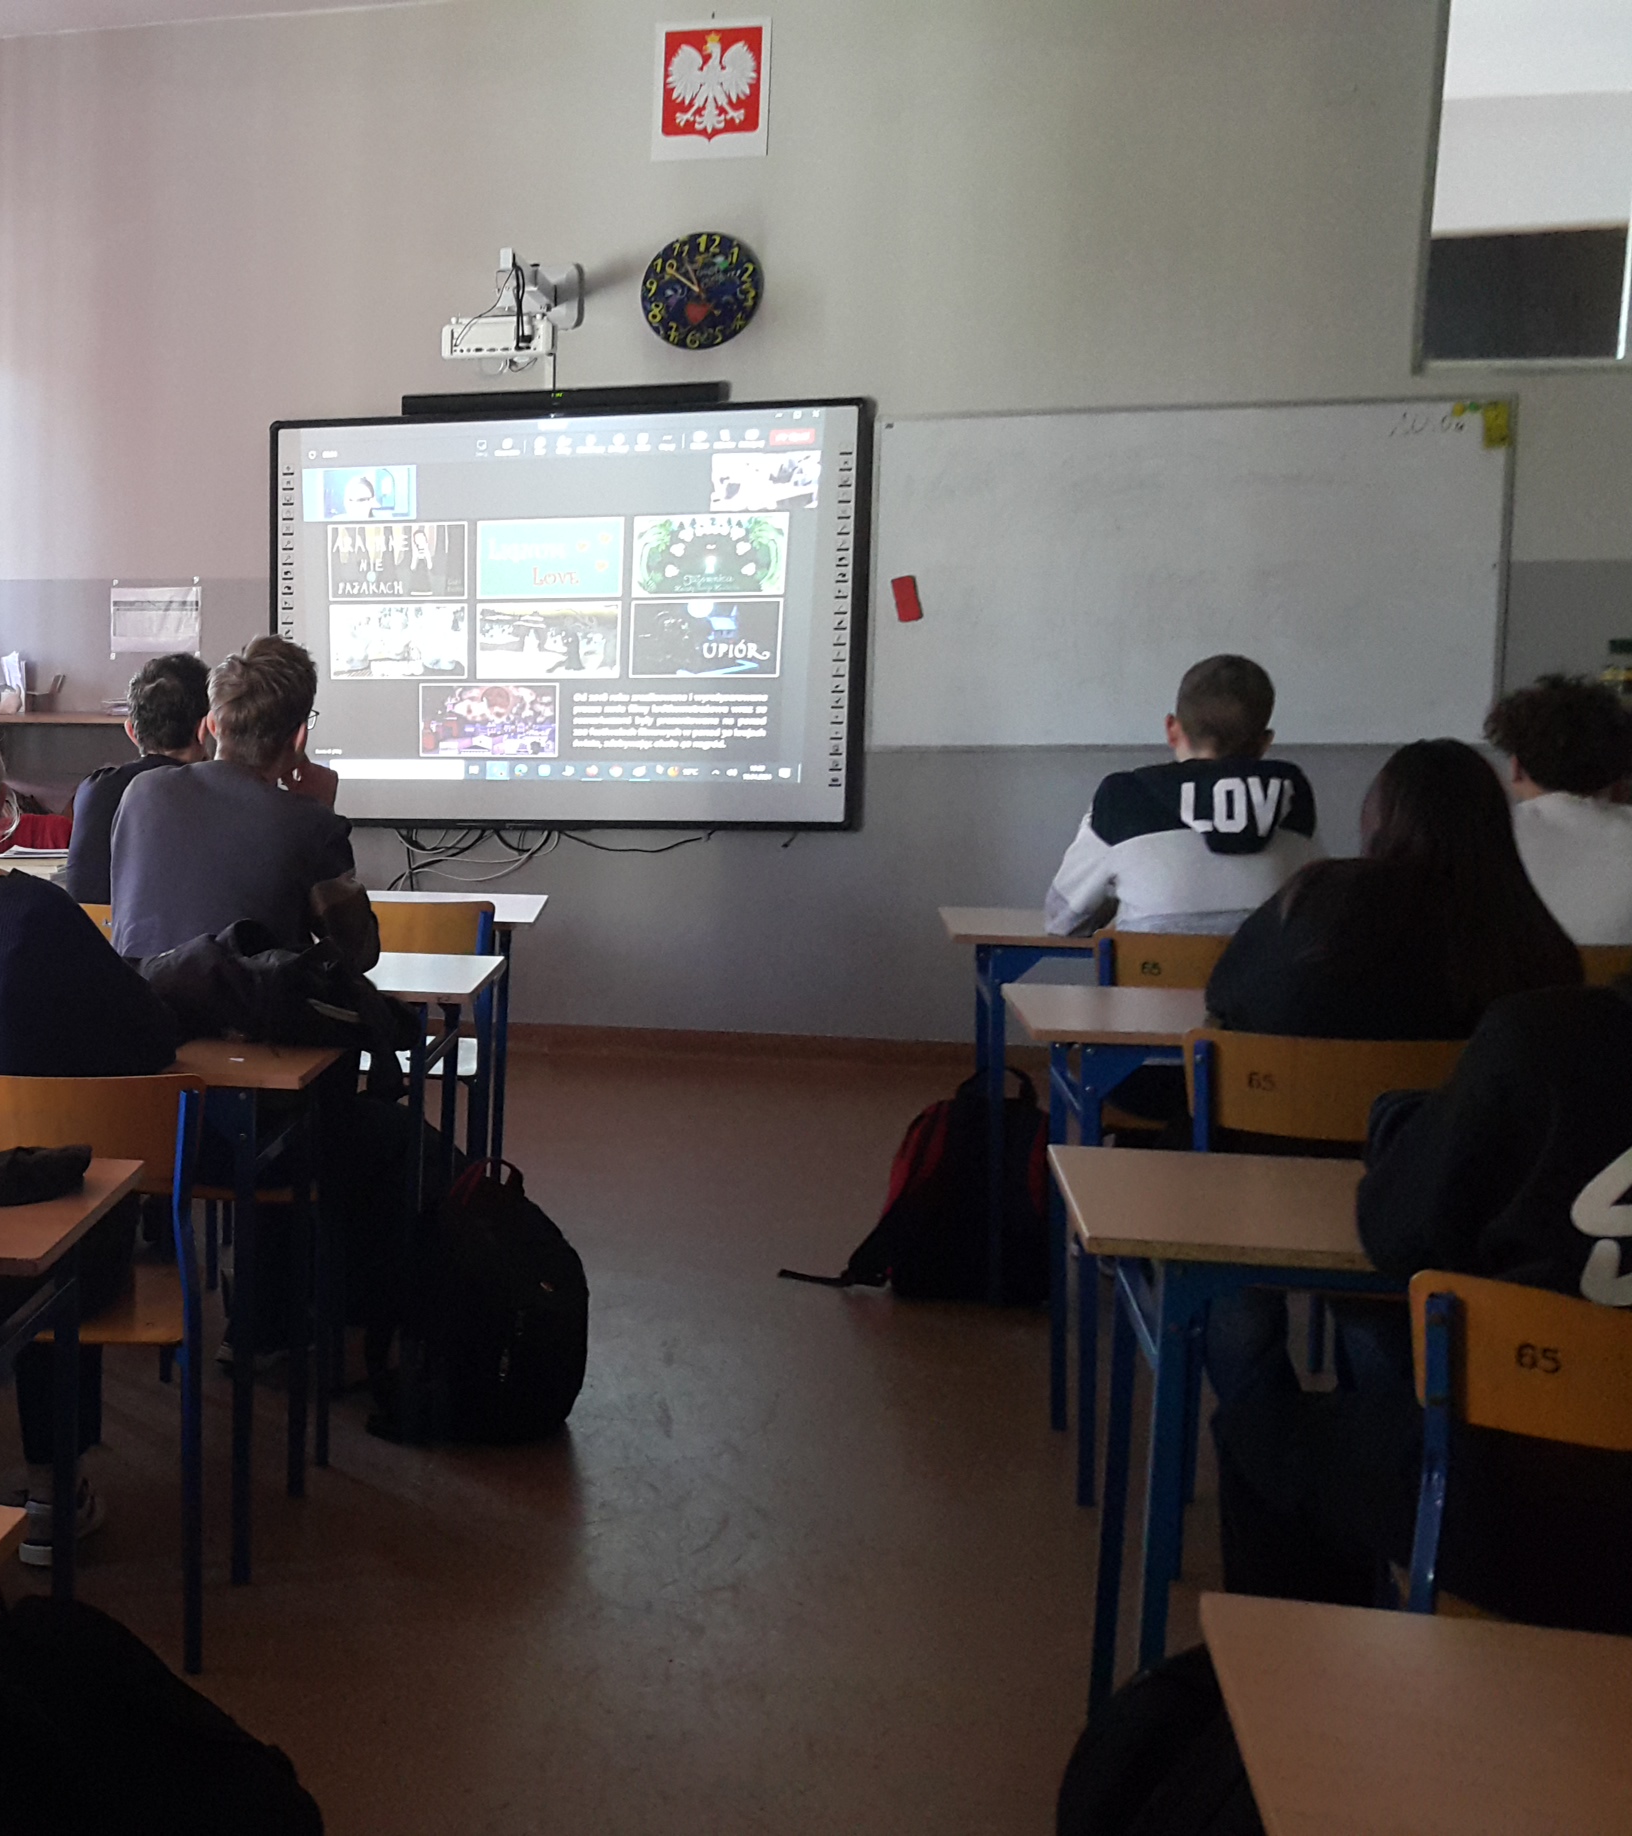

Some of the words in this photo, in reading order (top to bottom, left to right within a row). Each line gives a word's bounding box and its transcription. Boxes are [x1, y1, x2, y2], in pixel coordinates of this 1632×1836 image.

[672, 241, 690, 257] 11
[696, 234, 721, 254] 12
[729, 246, 740, 265] 1
[653, 257, 677, 274] 10
[741, 262, 754, 281] 2
[646, 278, 658, 297] 9
[742, 282, 756, 307] 3
[648, 302, 664, 323] 8
[668, 321, 679, 343] 7
[686, 331, 700, 348] 6
[714, 326, 725, 344] 5
[1141, 961, 1162, 976] 65
[1247, 1071, 1275, 1093] 65
[1514, 1342, 1562, 1374] 65
